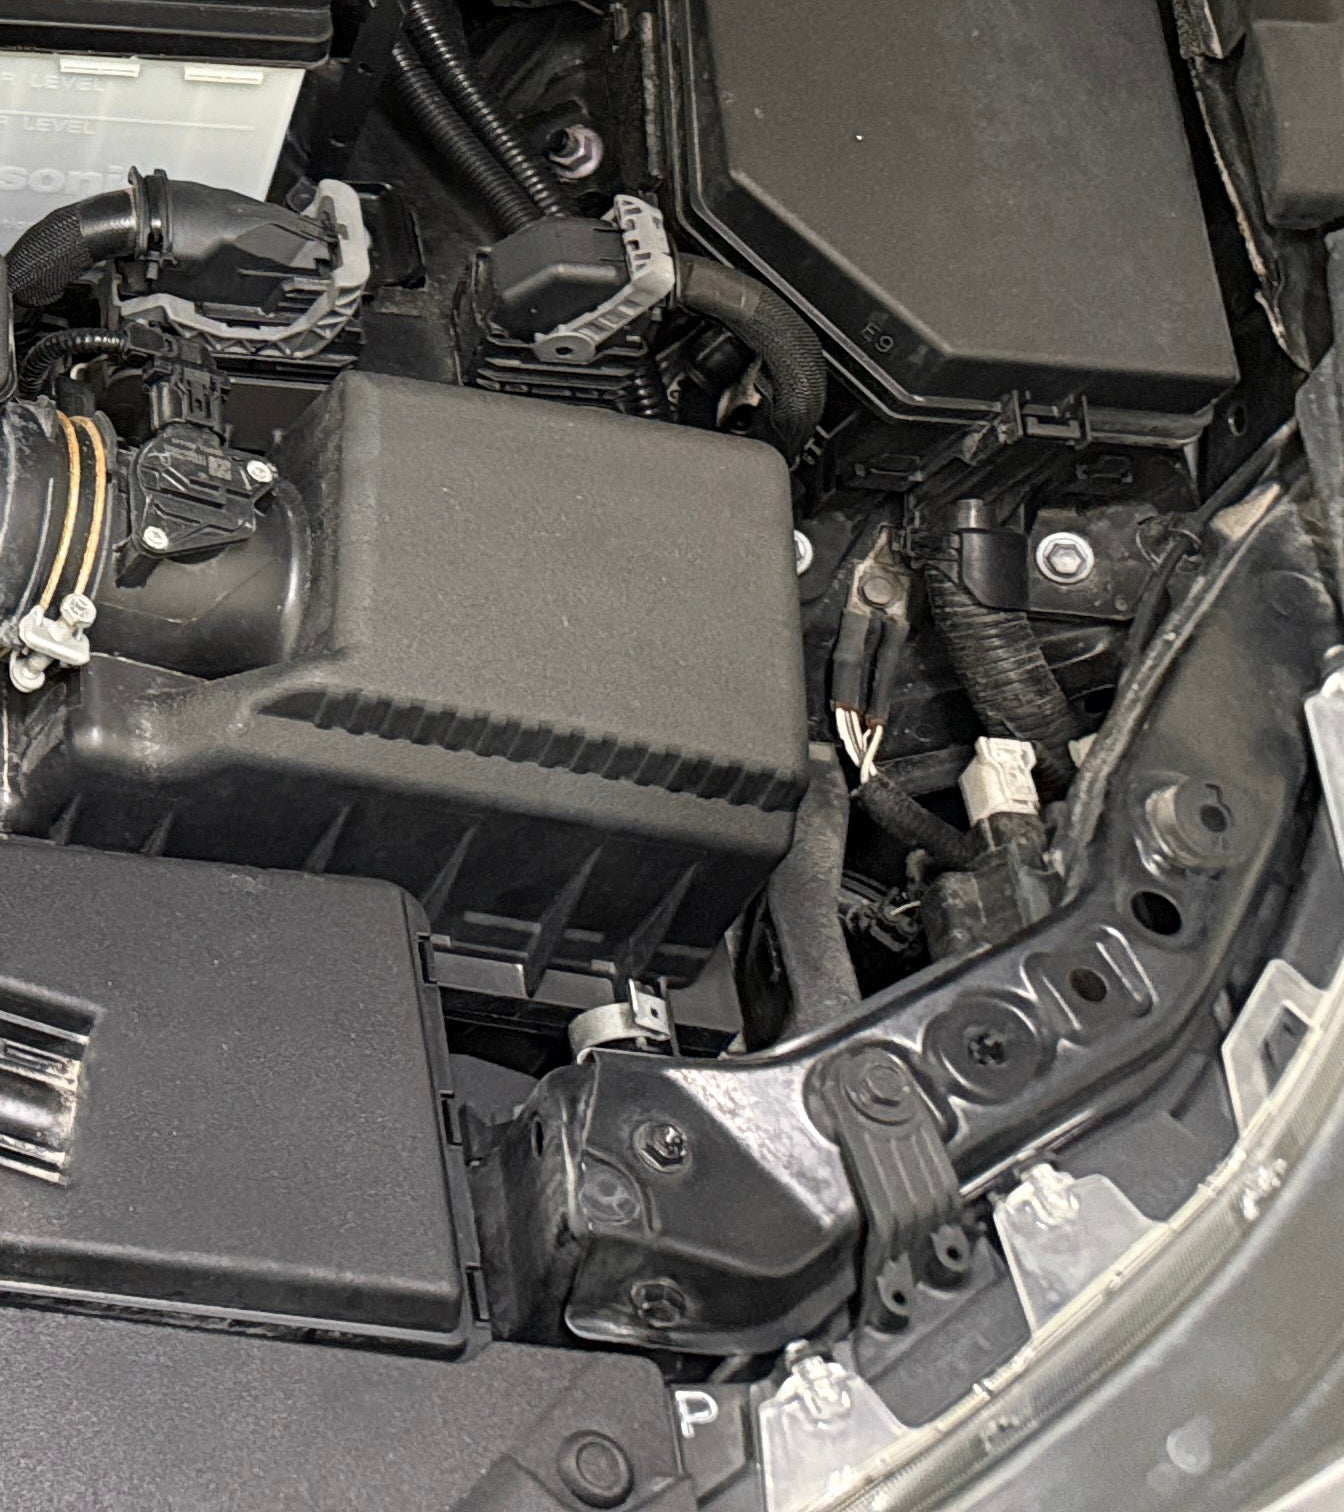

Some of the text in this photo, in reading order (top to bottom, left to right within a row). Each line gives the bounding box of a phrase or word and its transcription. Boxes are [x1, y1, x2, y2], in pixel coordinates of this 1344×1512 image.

[30, 73, 107, 92] LEVEL
[22, 116, 97, 135] LEVEL
[677, 1388, 719, 1440] P
